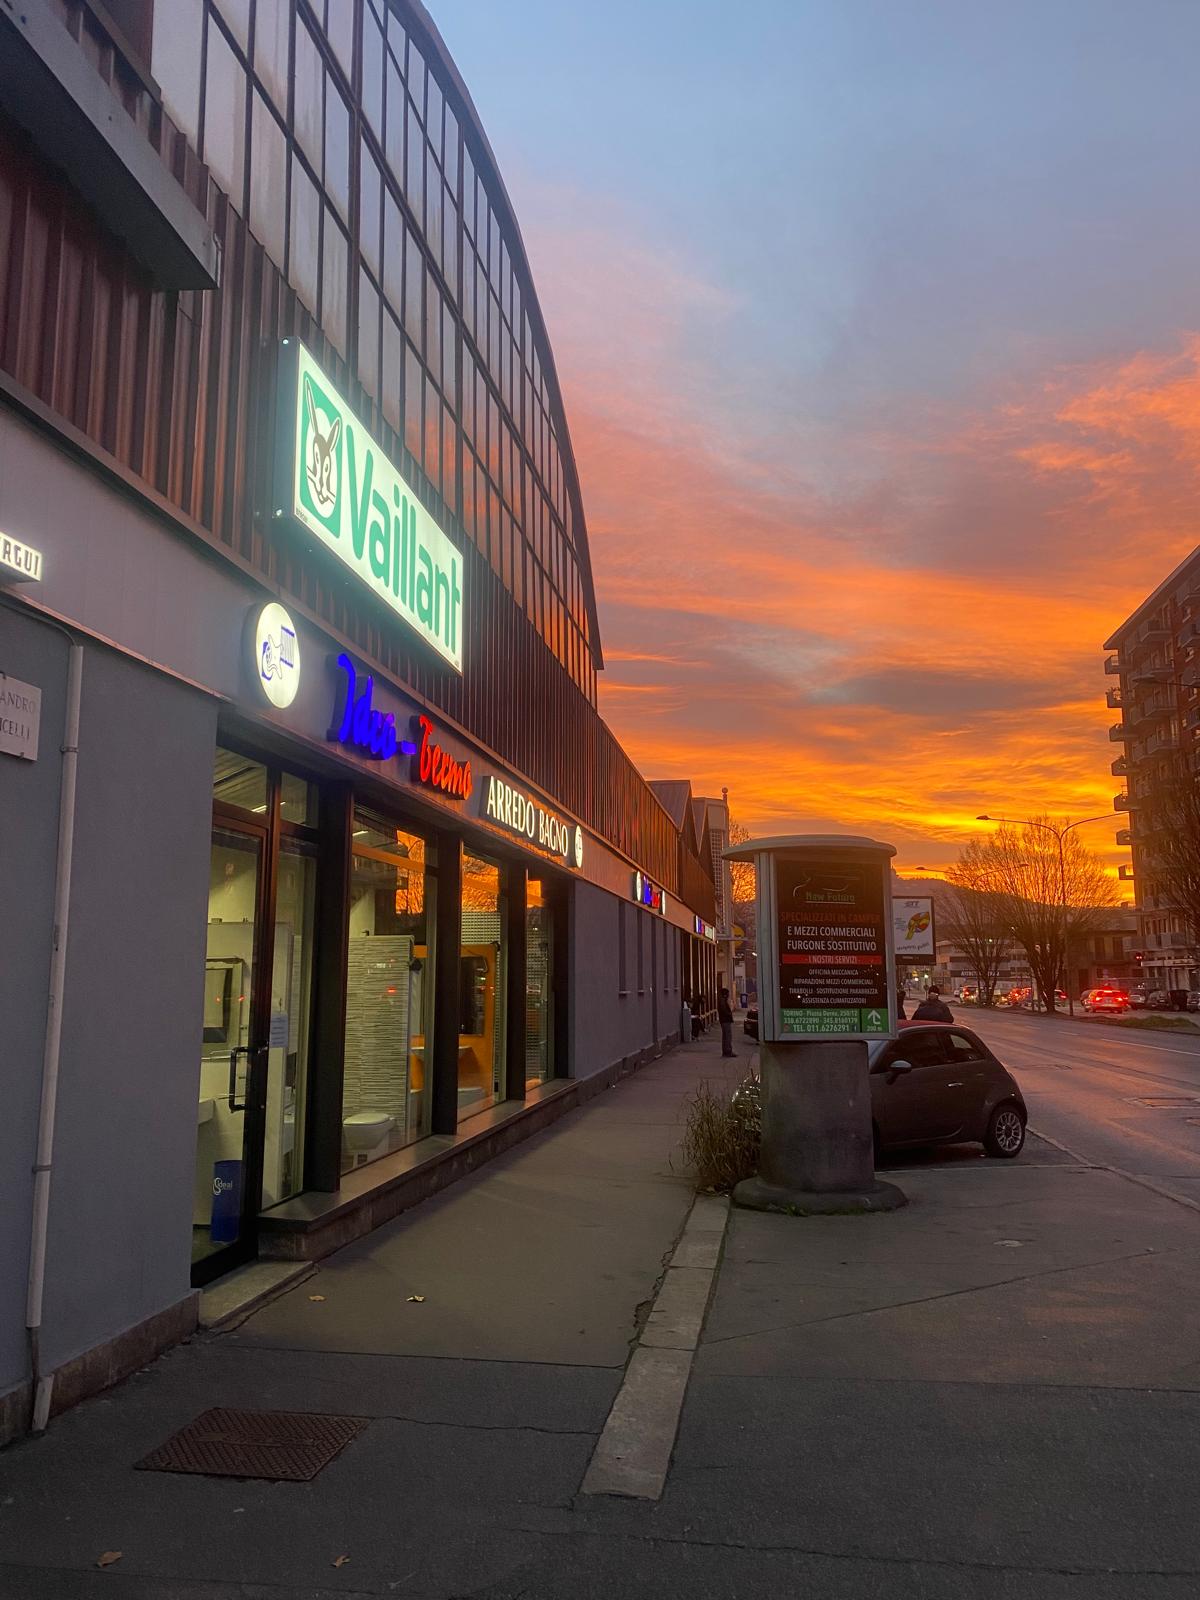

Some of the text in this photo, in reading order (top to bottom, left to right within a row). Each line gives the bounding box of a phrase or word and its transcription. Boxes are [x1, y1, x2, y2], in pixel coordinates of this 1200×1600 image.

[346, 424, 460, 655] Vaillant
[0, 536, 39, 576] RGUI
[486, 775, 569, 857] ARREDO BAGNO
[787, 926, 876, 937] E MEZZI COMMERCIALI
[787, 940, 877, 951] FURGONE SOSTITUTIVO
[812, 955, 834, 964] NOSTRI
[835, 955, 857, 964] SERVIZI
